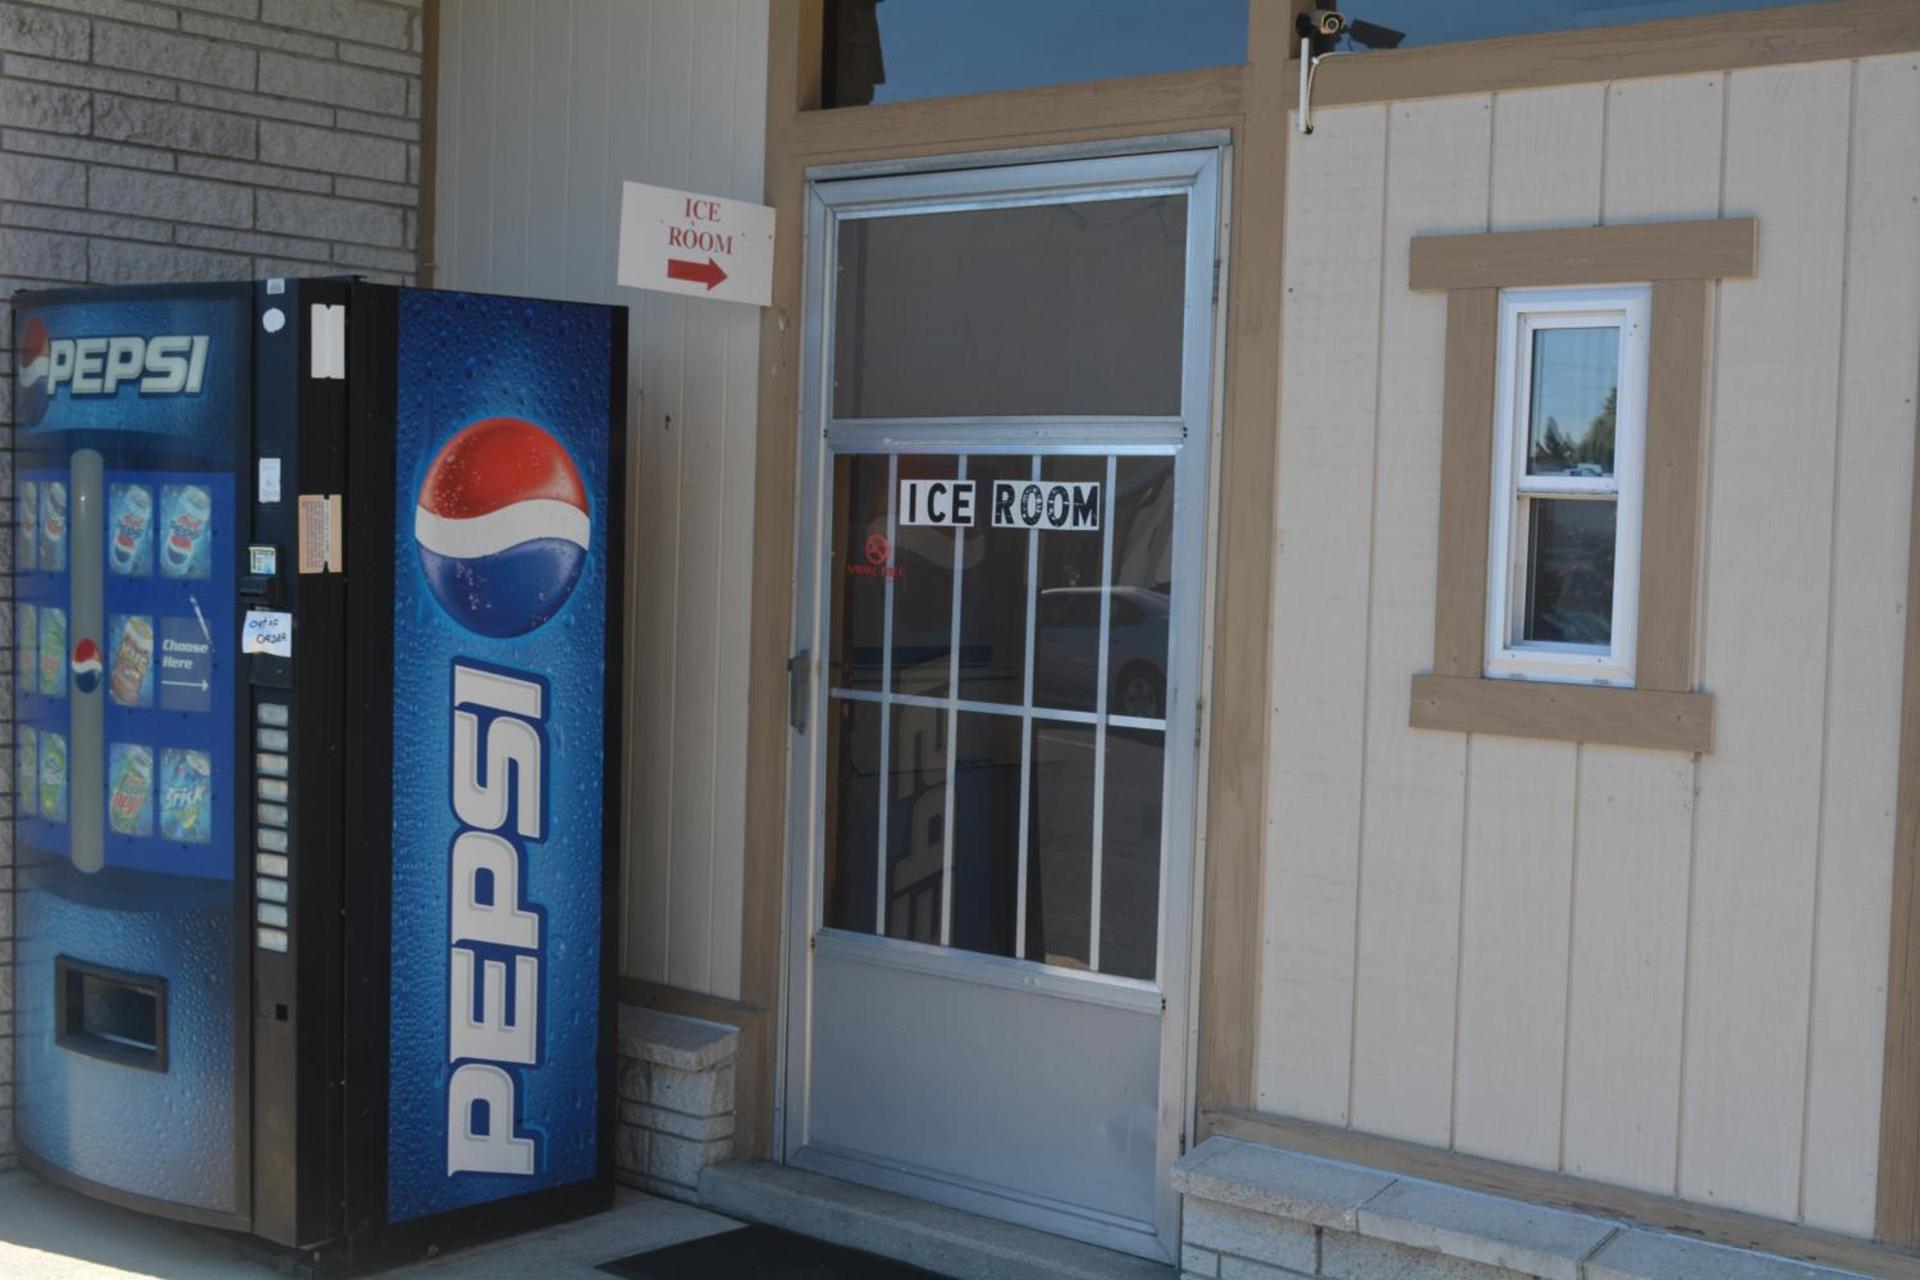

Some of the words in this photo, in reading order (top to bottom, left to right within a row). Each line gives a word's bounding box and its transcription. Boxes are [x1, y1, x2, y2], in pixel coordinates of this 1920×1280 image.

[684, 198, 722, 222] ICE
[668, 226, 733, 255] ROOM
[47, 335, 210, 395] PEPSI
[908, 483, 973, 524] ICE
[993, 484, 1099, 527] ROOM
[162, 639, 209, 654] Choose
[162, 656, 194, 669] Here
[448, 664, 543, 1177] PEPSI
